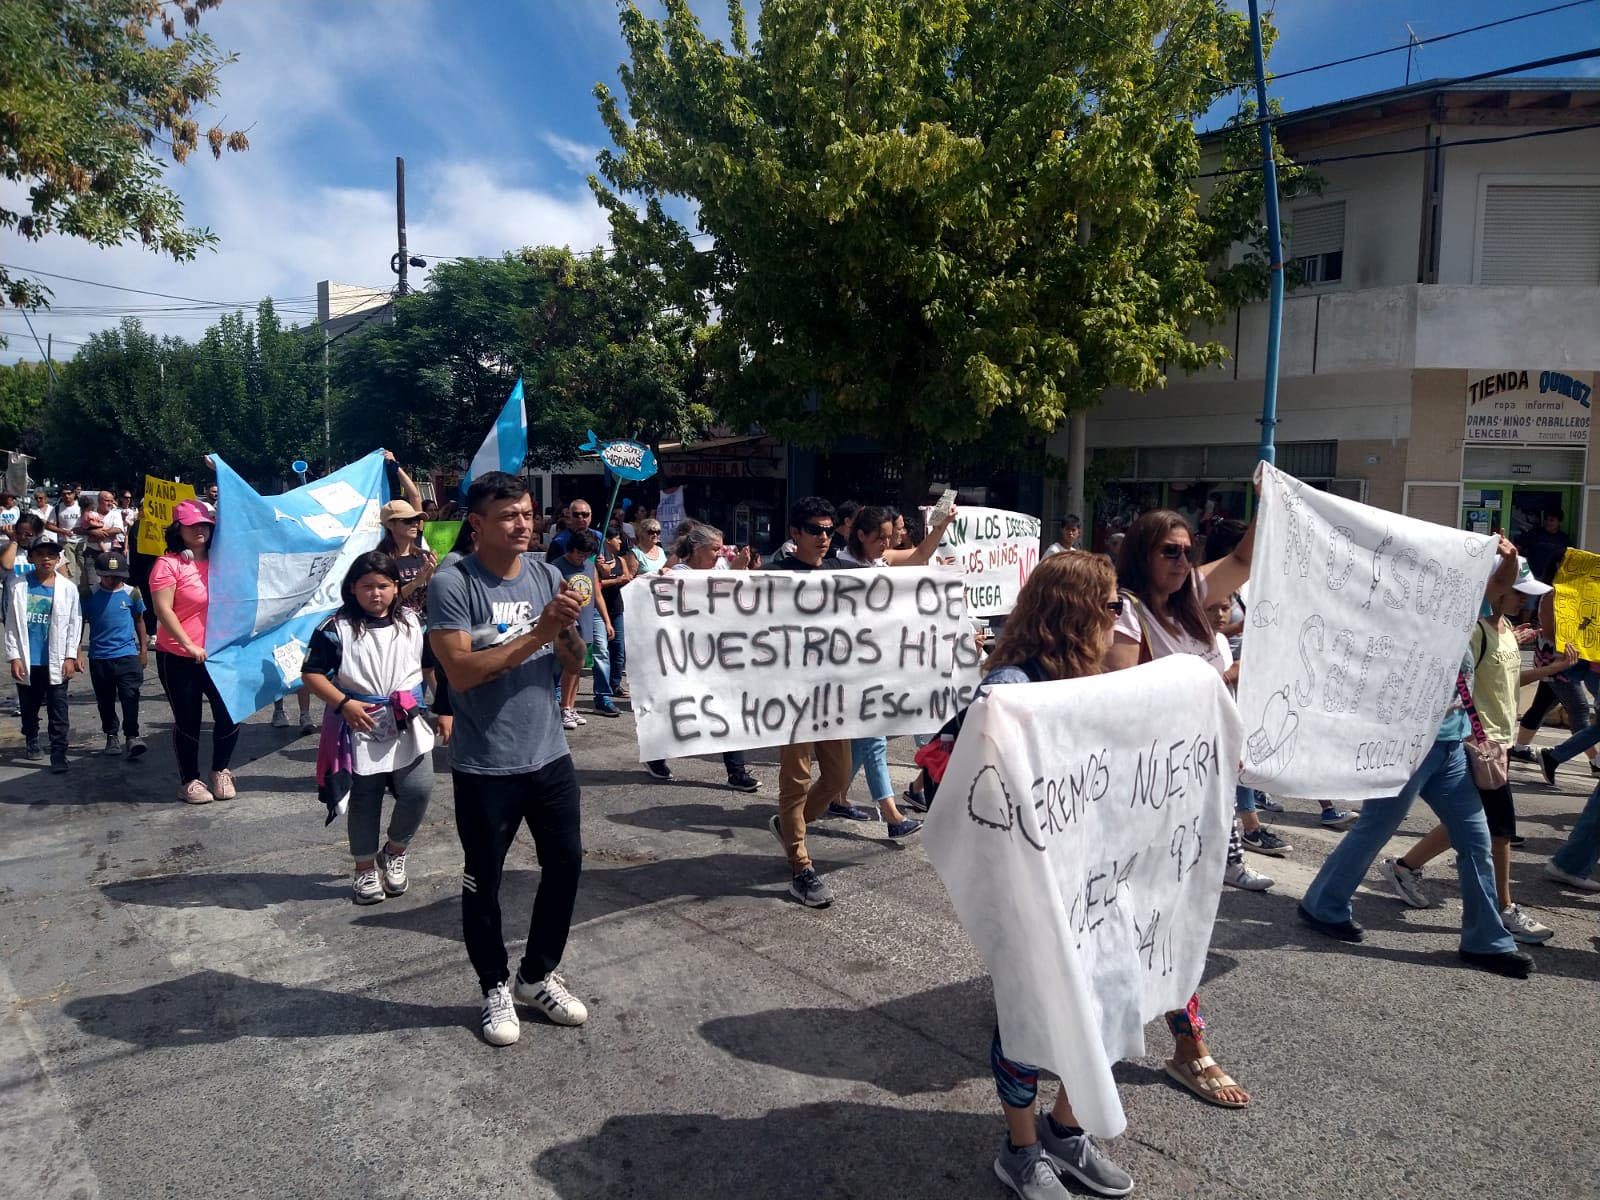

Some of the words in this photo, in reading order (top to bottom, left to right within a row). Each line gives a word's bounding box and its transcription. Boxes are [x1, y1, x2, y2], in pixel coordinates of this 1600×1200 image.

[1469, 371, 1529, 405] TIENDA
[1494, 401, 1516, 411] ropa
[1525, 400, 1564, 410] informal
[1467, 415, 1499, 426] DAMAS
[1504, 414, 1530, 426] NIÑOS
[1536, 416, 1590, 428] CABALLEROS
[1469, 429, 1519, 439] LENCERIA
[609, 445, 623, 453] NO
[156, 481, 177, 501] AÑO
[975, 515, 1000, 540] LOS
[1284, 506, 1355, 591] NO
[492, 601, 533, 624] NIKE
[650, 577, 699, 617] EL
[705, 574, 894, 617] FUTURO
[915, 577, 964, 622] DE
[656, 625, 882, 676] NUESTROS
[669, 694, 730, 741] ES
[741, 683, 844, 743] HOY!!!
[1131, 734, 1220, 810] NUESTRA
[1170, 816, 1202, 882] 95
